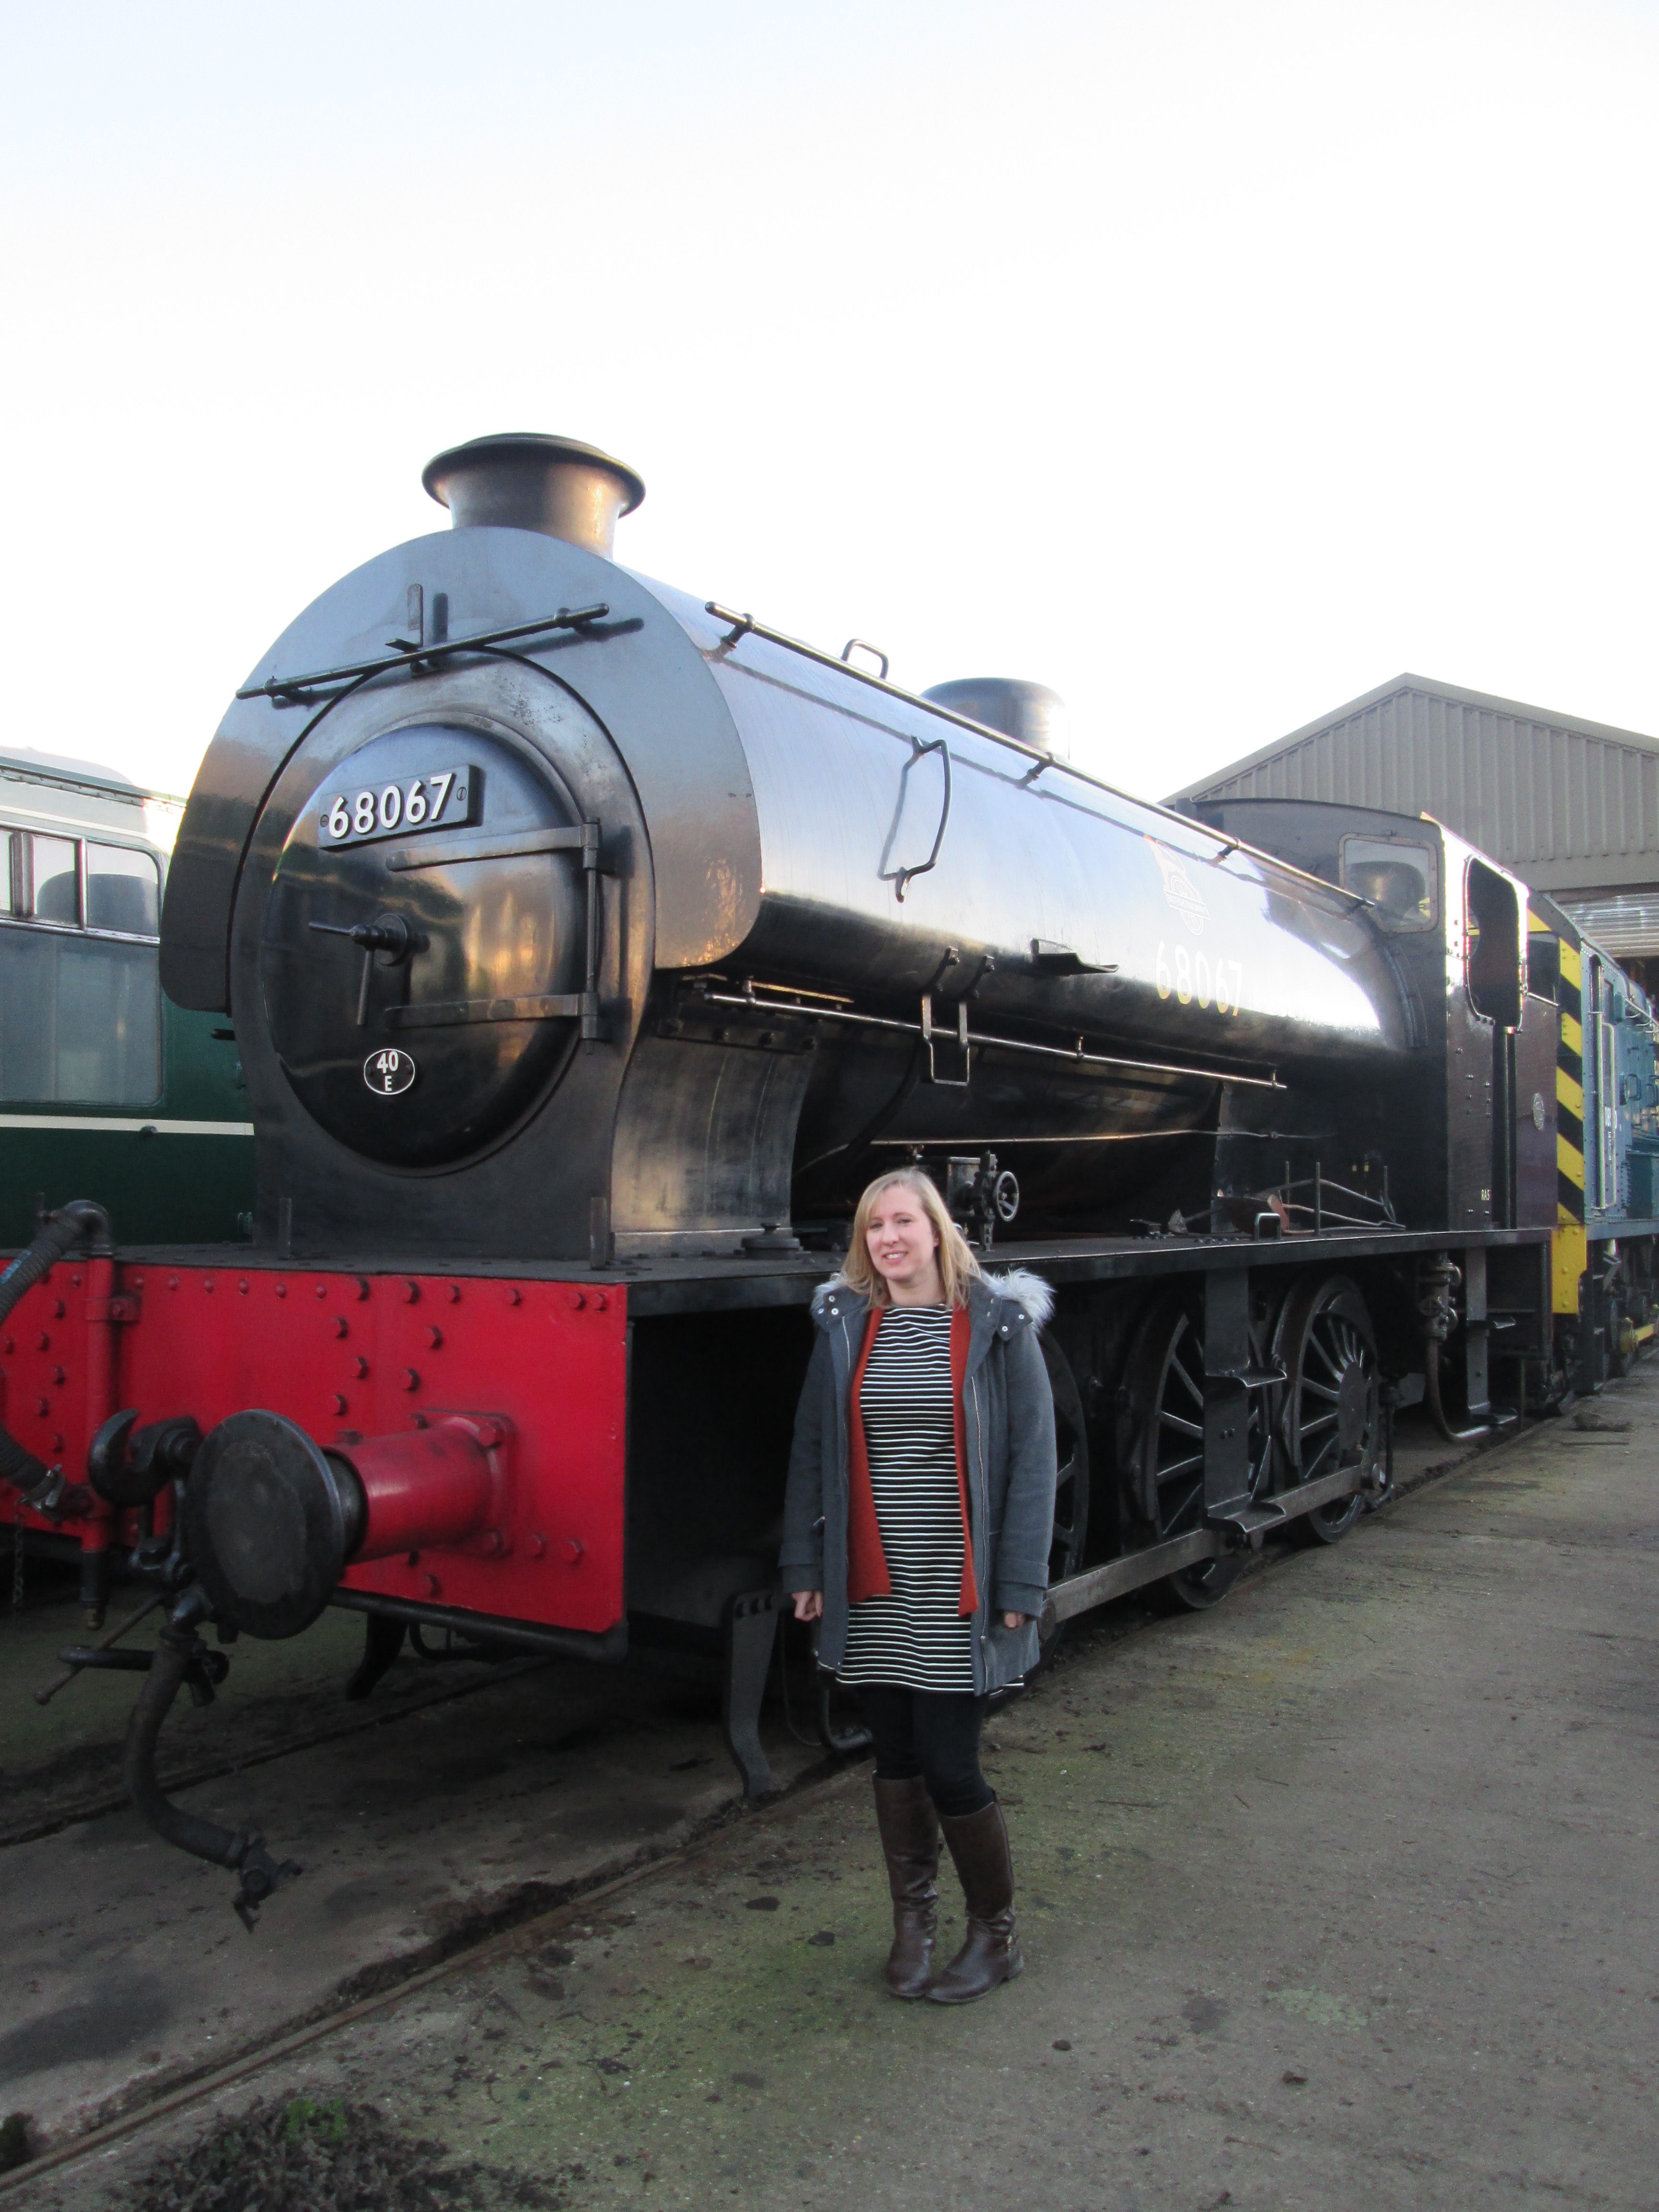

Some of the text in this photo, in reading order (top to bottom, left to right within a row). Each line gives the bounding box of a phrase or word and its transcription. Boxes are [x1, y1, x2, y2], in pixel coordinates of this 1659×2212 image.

[329, 773, 453, 839] 68067
[1155, 940, 1242, 1017] 68067
[377, 1051, 398, 1074] 40
[385, 1075, 392, 1092] E
